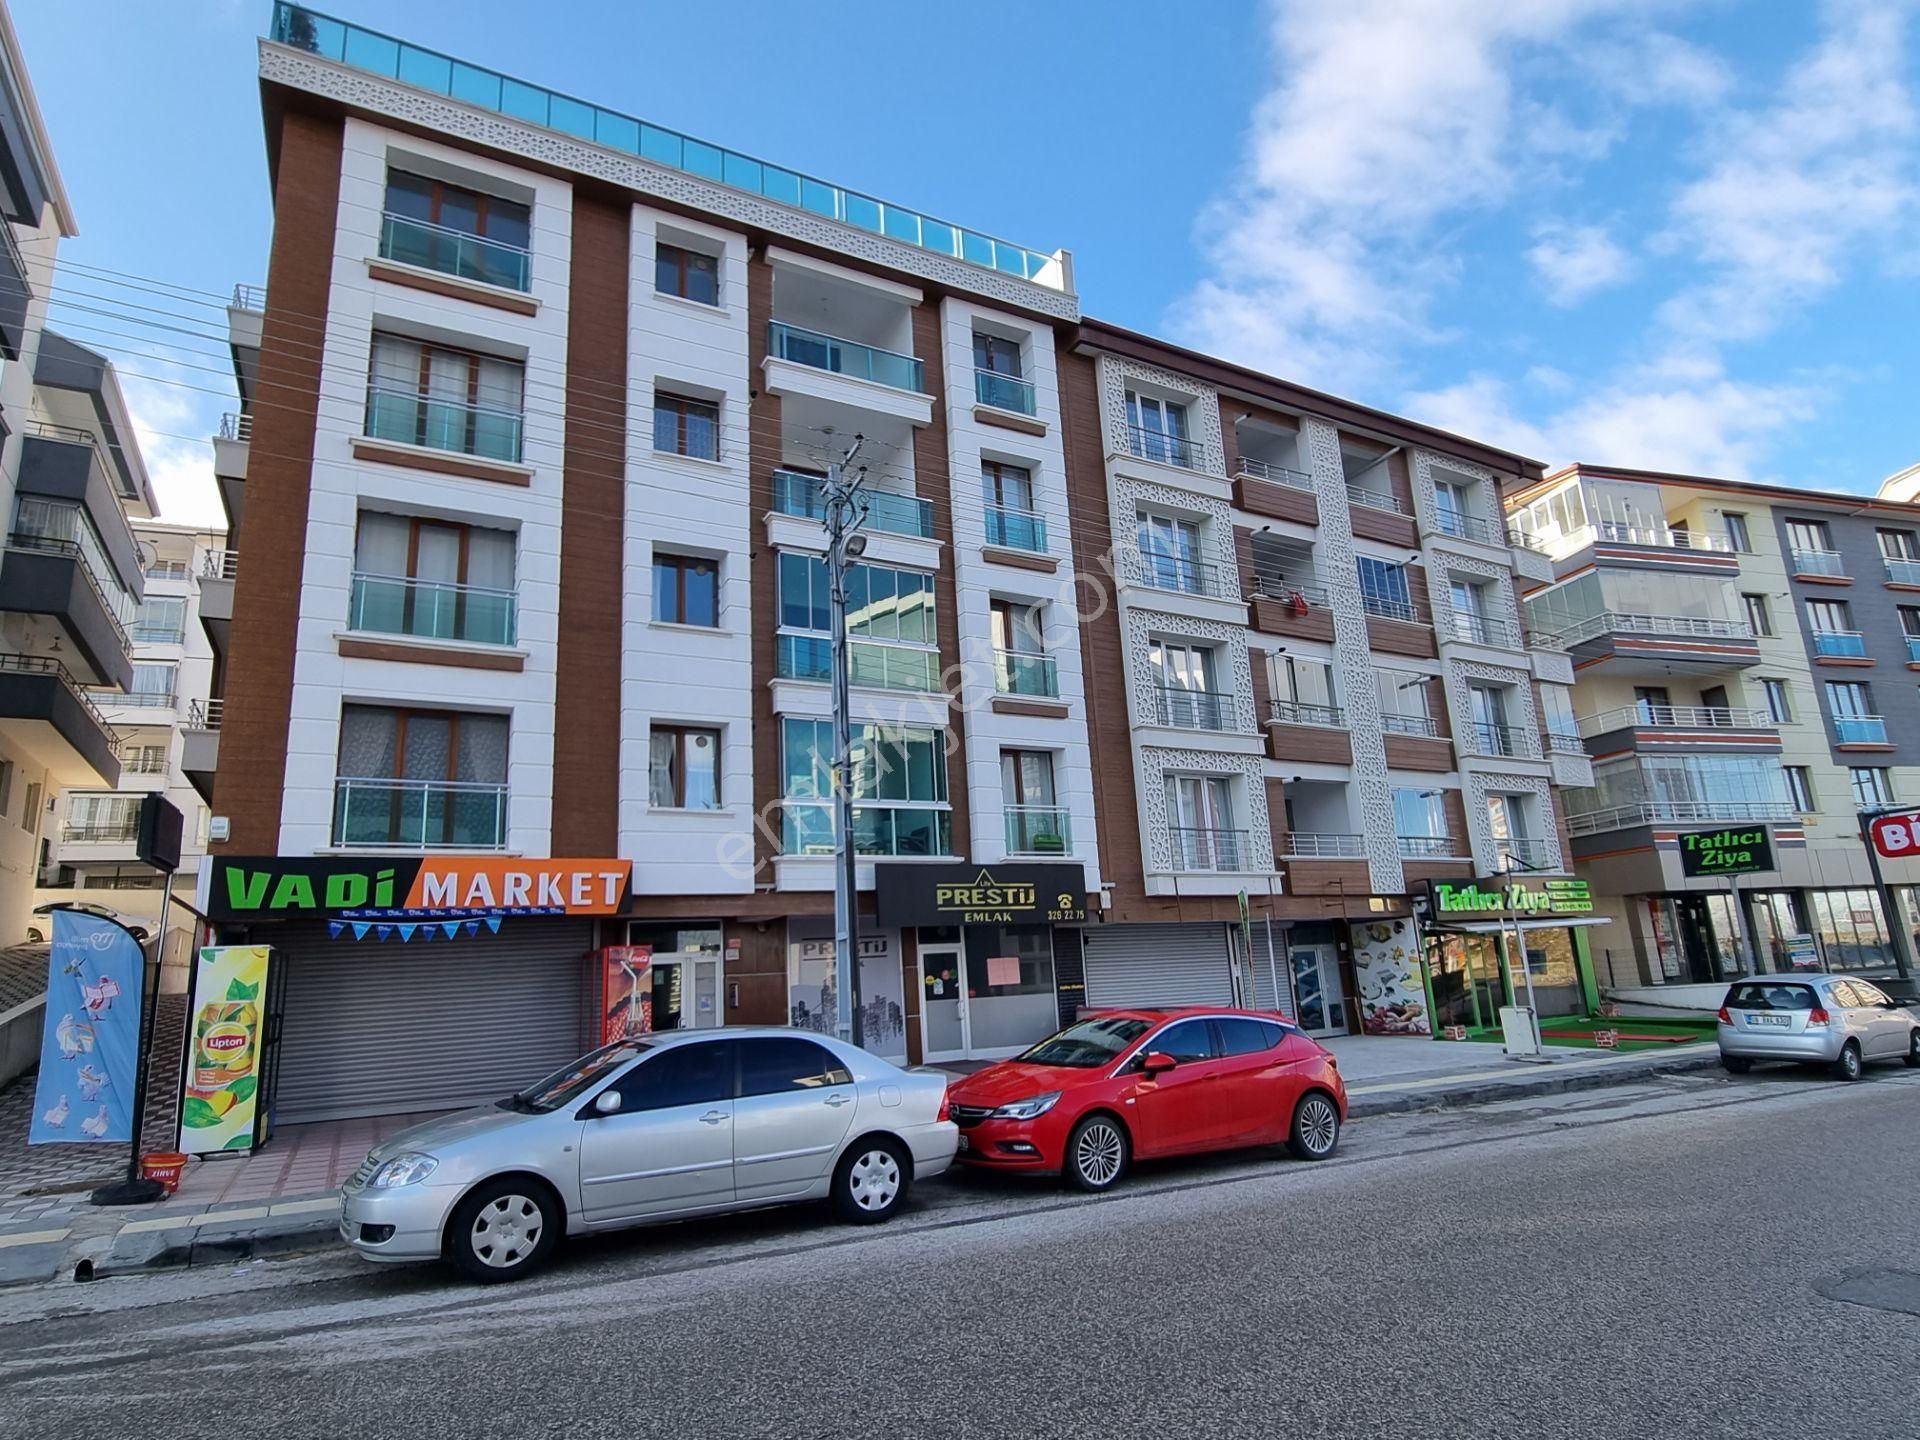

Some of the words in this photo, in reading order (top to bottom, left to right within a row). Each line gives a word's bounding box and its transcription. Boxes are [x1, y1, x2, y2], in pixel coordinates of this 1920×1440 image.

[1701, 850, 1752, 867] Ziya
[422, 872, 624, 907] MARKET
[1503, 883, 1551, 915] Ziya
[964, 911, 1013, 923] EMLAK
[1064, 910, 1074, 920] 22
[1076, 910, 1085, 919] 75
[209, 1038, 244, 1048] Lipton
